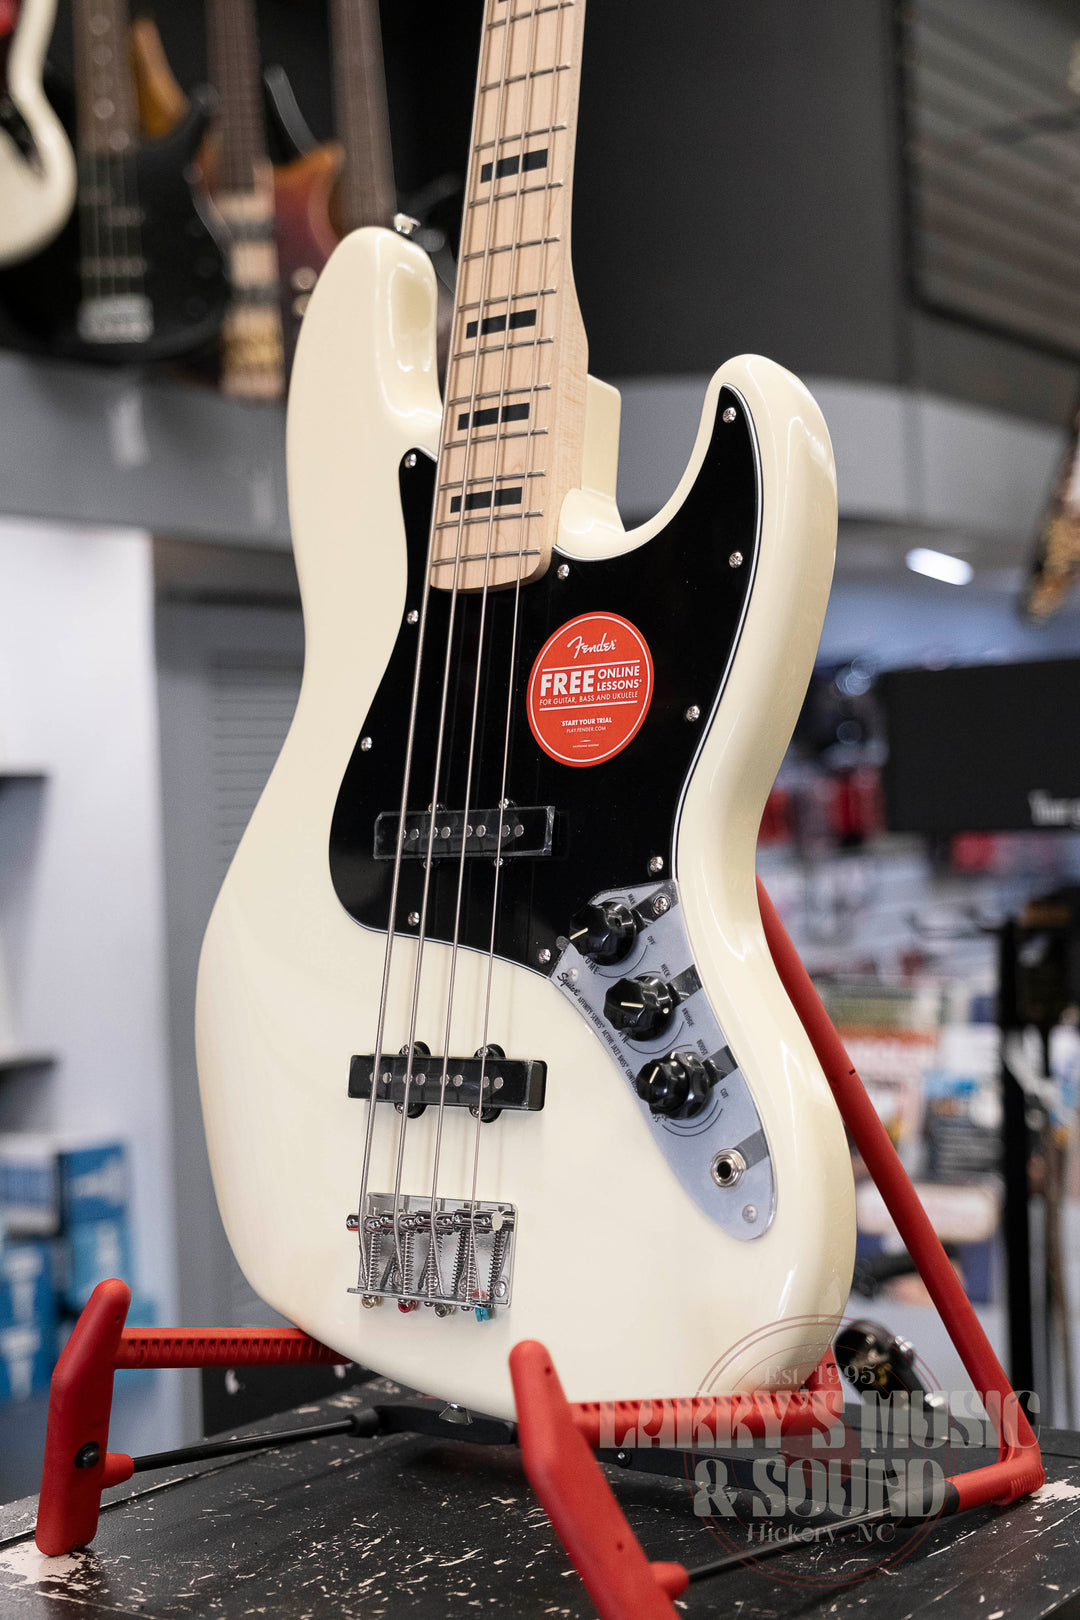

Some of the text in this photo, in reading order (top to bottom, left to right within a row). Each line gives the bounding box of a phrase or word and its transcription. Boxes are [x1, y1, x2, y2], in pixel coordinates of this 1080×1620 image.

[566, 632, 617, 659] Fender
[540, 665, 640, 697] FREE ONLINE
[539, 691, 638, 706] FOR GUITAR, BASS AND UKULELE
[557, 972, 581, 997] Squier
[720, 1088, 729, 1098] CUT
